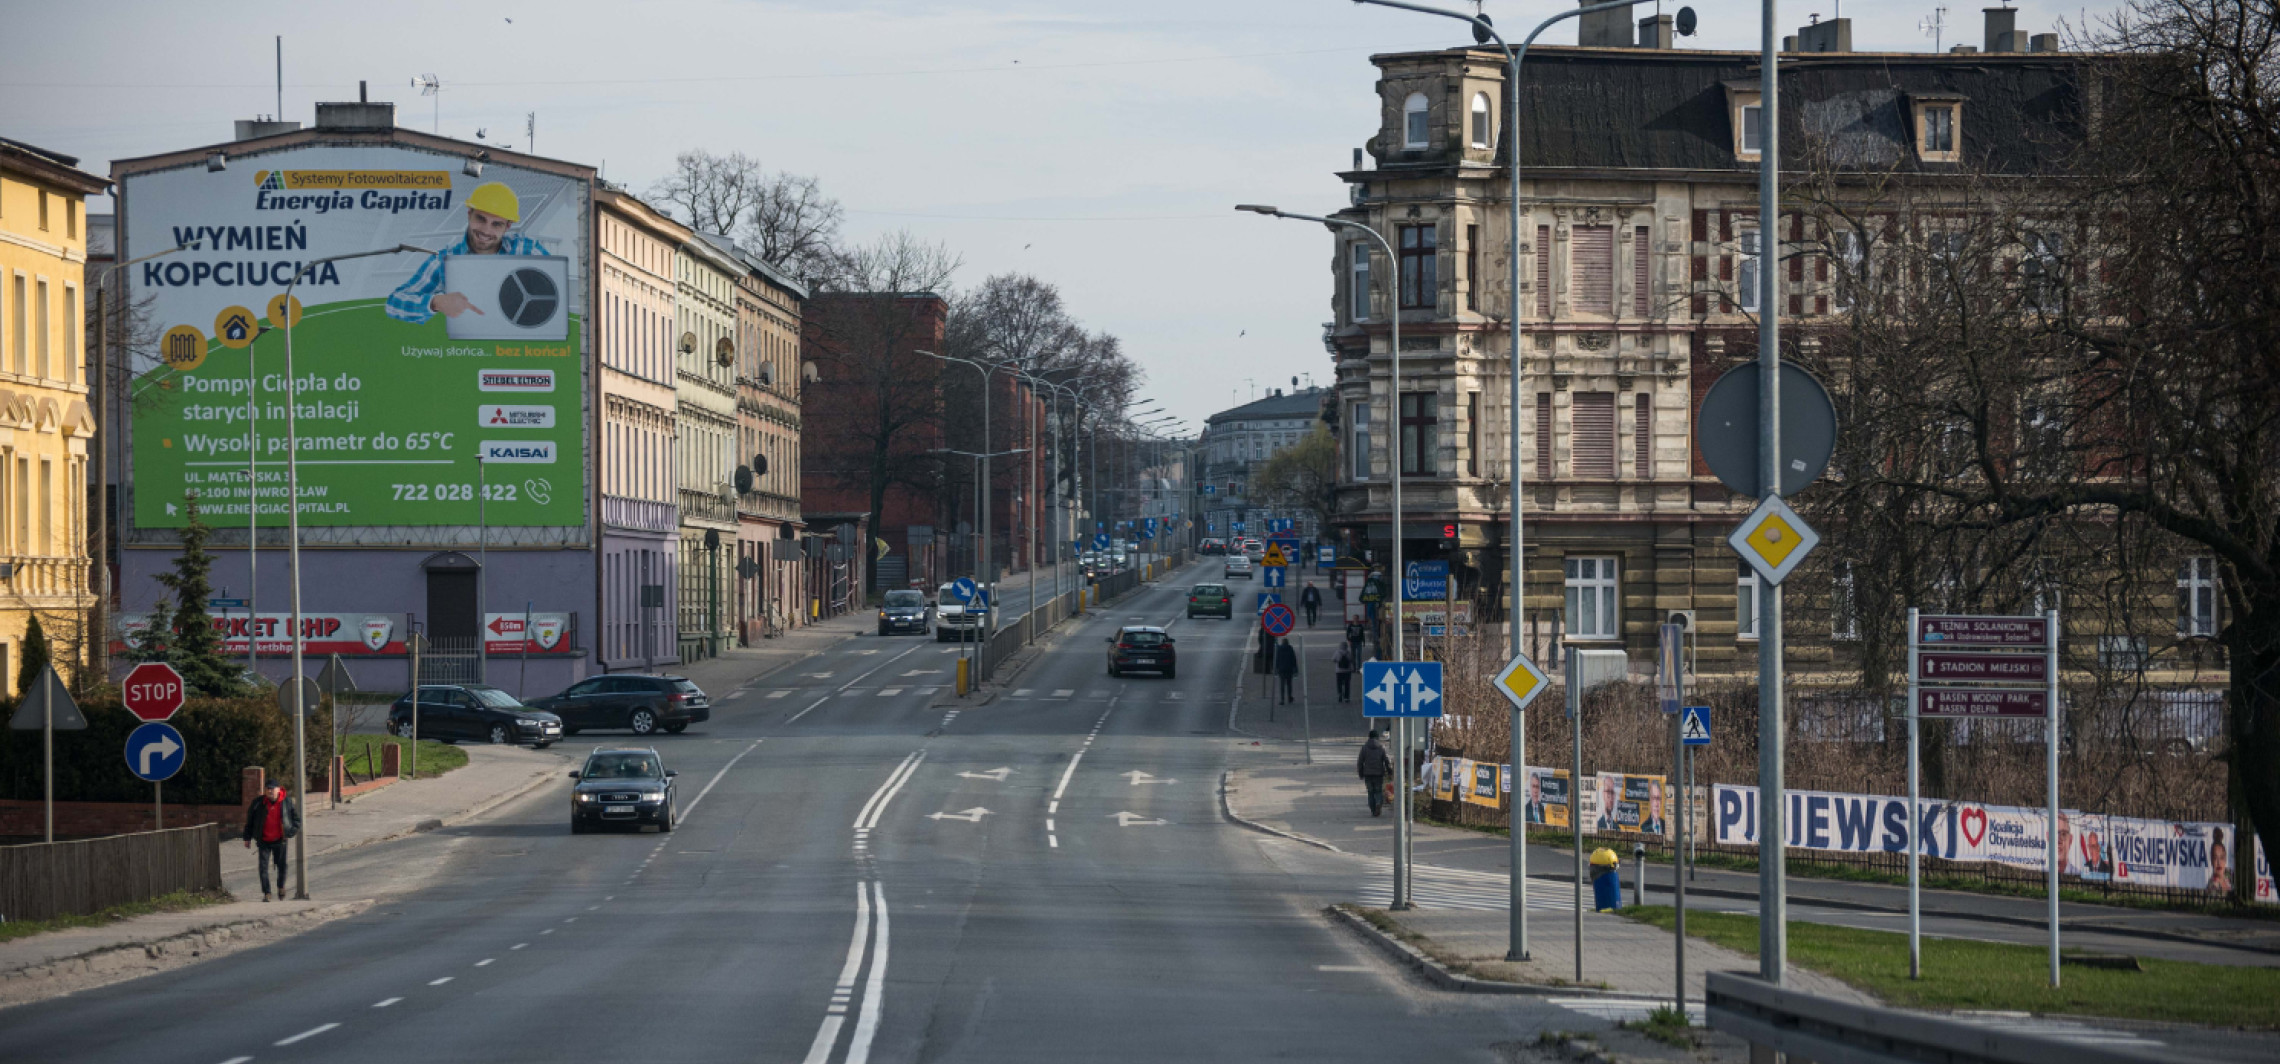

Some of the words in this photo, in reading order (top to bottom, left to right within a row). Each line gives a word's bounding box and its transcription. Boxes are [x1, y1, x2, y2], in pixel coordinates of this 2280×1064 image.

[291, 173, 343, 187] Systemy
[348, 172, 443, 185] Fotowoltaiczne
[256, 190, 354, 214] Energia
[360, 189, 452, 214] Capital
[172, 219, 307, 251] WYMIEŃ
[144, 260, 340, 287] KOPCIUCHA
[401, 346, 443, 359] Używaj
[495, 345, 520, 357] bez
[524, 345, 571, 357] końca!
[183, 375, 256, 397] Pompy
[262, 373, 327, 395] Ciepła
[334, 372, 361, 391] do
[482, 376, 517, 385] STIEBEL
[518, 376, 551, 385] ELTRON
[183, 402, 260, 424] starych
[184, 432, 261, 456] Wysoki
[268, 434, 366, 455] parametr
[372, 431, 399, 450] do
[405, 431, 454, 450] 65°C
[185, 472, 205, 483] UL.
[391, 484, 428, 501] 722
[435, 484, 473, 501] 028
[480, 484, 517, 501] 422
[286, 617, 341, 639] BHP
[1973, 621, 2030, 632] SOLANKOWA
[1943, 632, 1955, 640] ark
[1940, 662, 1986, 672] STADION
[1990, 662, 2030, 673] MIEJSKI
[130, 682, 177, 701] STOP
[1940, 692, 1968, 703] BASEN
[1972, 693, 2003, 703] WODNY
[2007, 693, 2030, 704] PARK
[1940, 704, 1966, 713] BASEN
[1970, 704, 1999, 713] DELFIN
[1989, 819, 2024, 837] Koalicja
[1989, 831, 2047, 850] Obywatelska
[2260, 881, 2267, 895] 2
